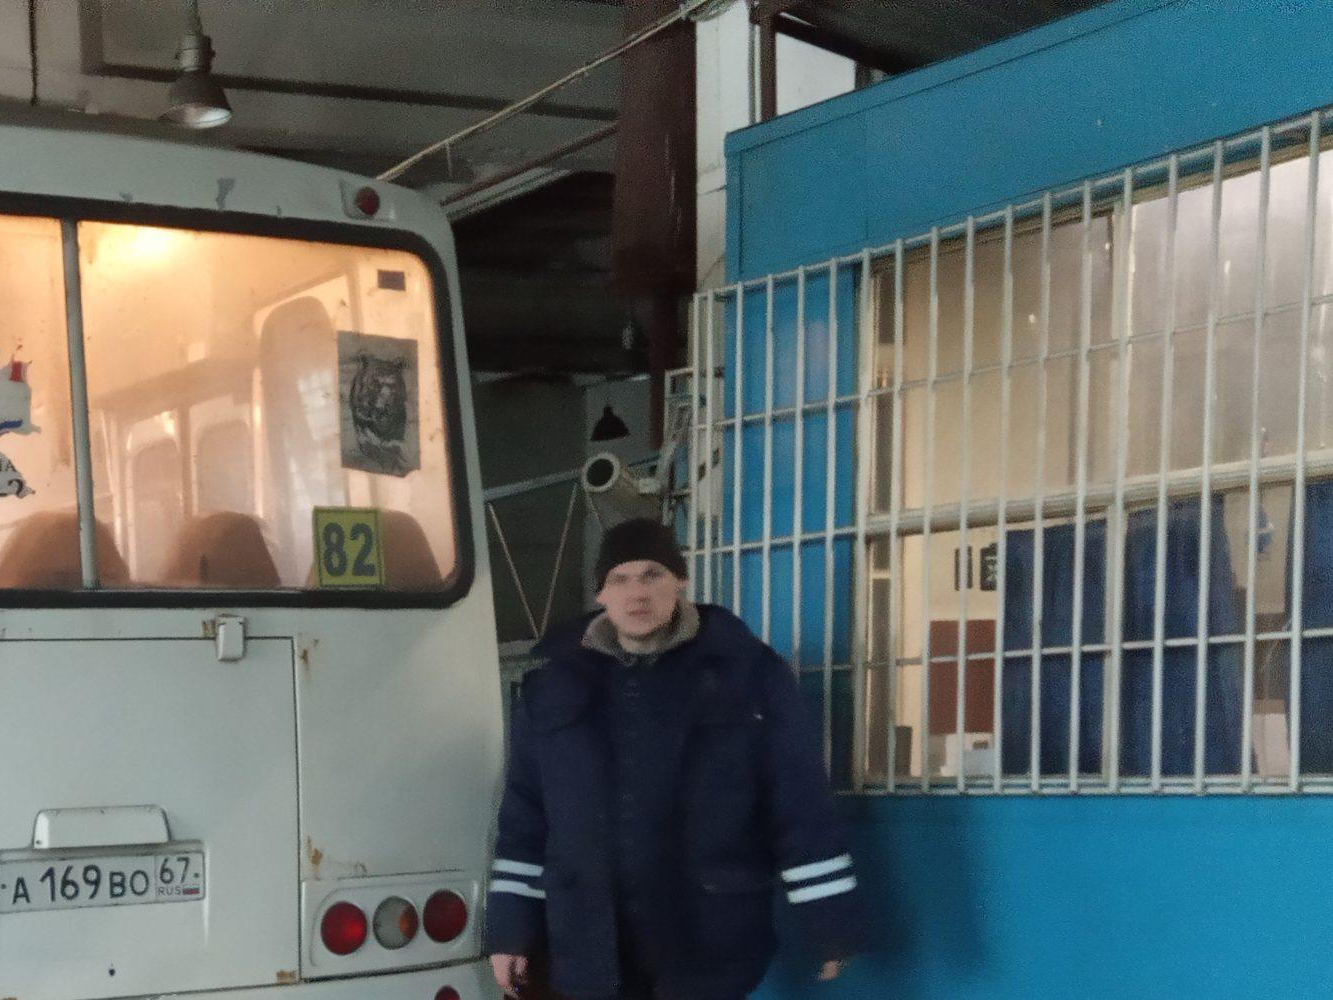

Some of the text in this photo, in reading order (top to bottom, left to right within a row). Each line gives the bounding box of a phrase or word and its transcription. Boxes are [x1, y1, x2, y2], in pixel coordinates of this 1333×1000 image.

[322, 522, 375, 577] 82
[12, 857, 190, 905] А169ВО 67
[157, 885, 182, 897] RUS
